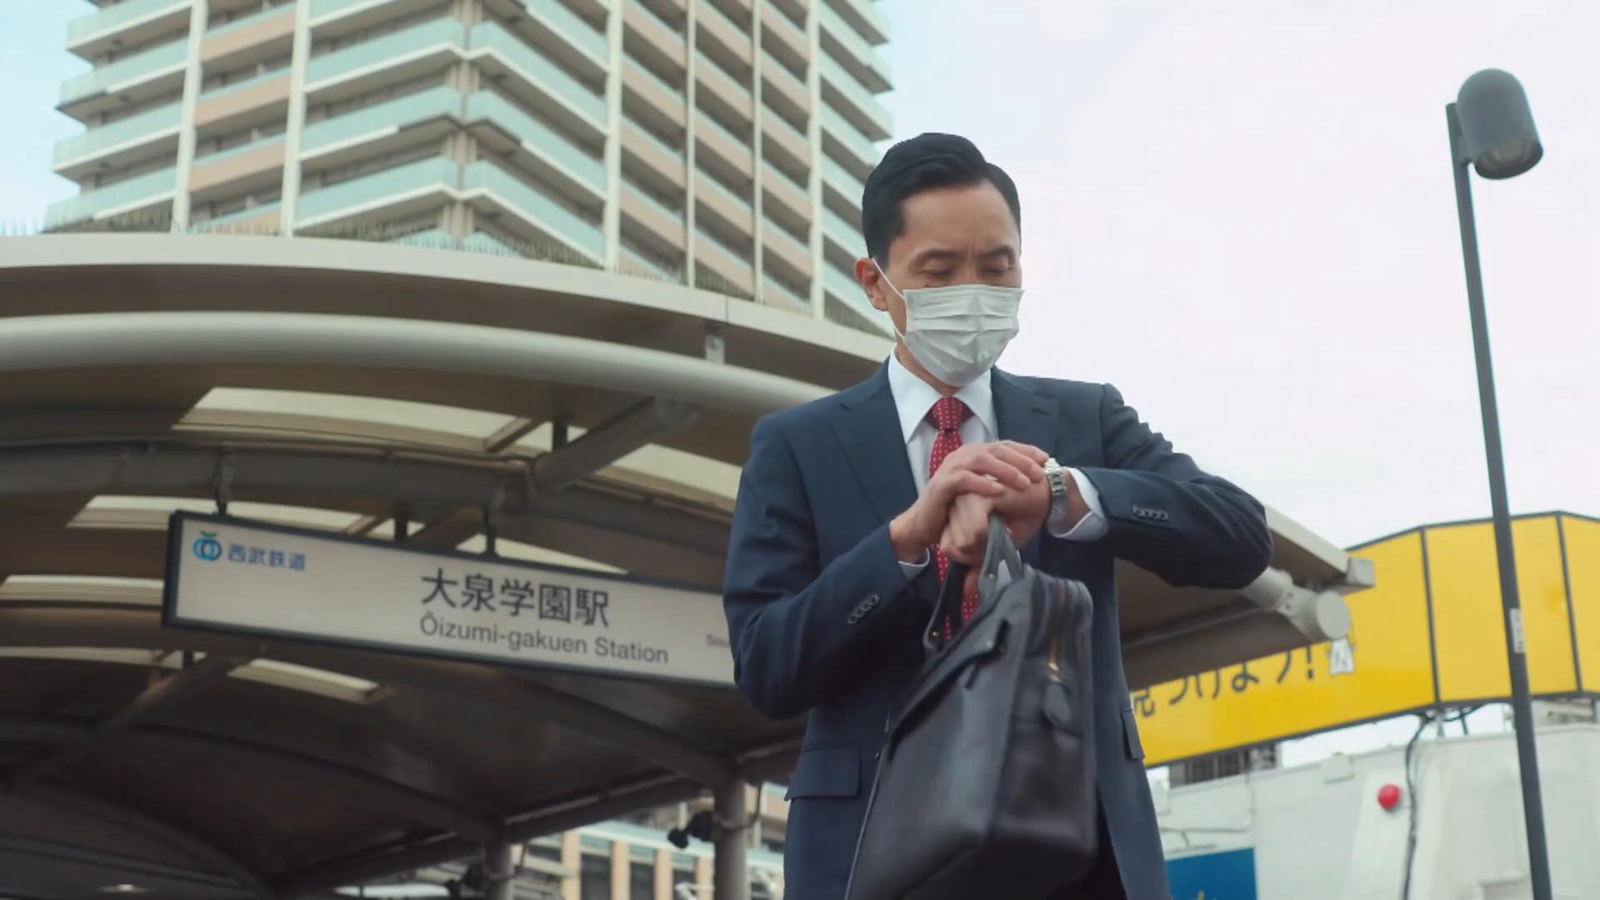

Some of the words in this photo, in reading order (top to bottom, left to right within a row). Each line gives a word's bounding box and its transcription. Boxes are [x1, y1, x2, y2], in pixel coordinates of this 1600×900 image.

[227, 543, 306, 571] 西武鉄道
[421, 567, 609, 628] 大泉学園駅
[420, 611, 588, 654] Ōizumi-gakuen
[594, 636, 669, 664] Station
